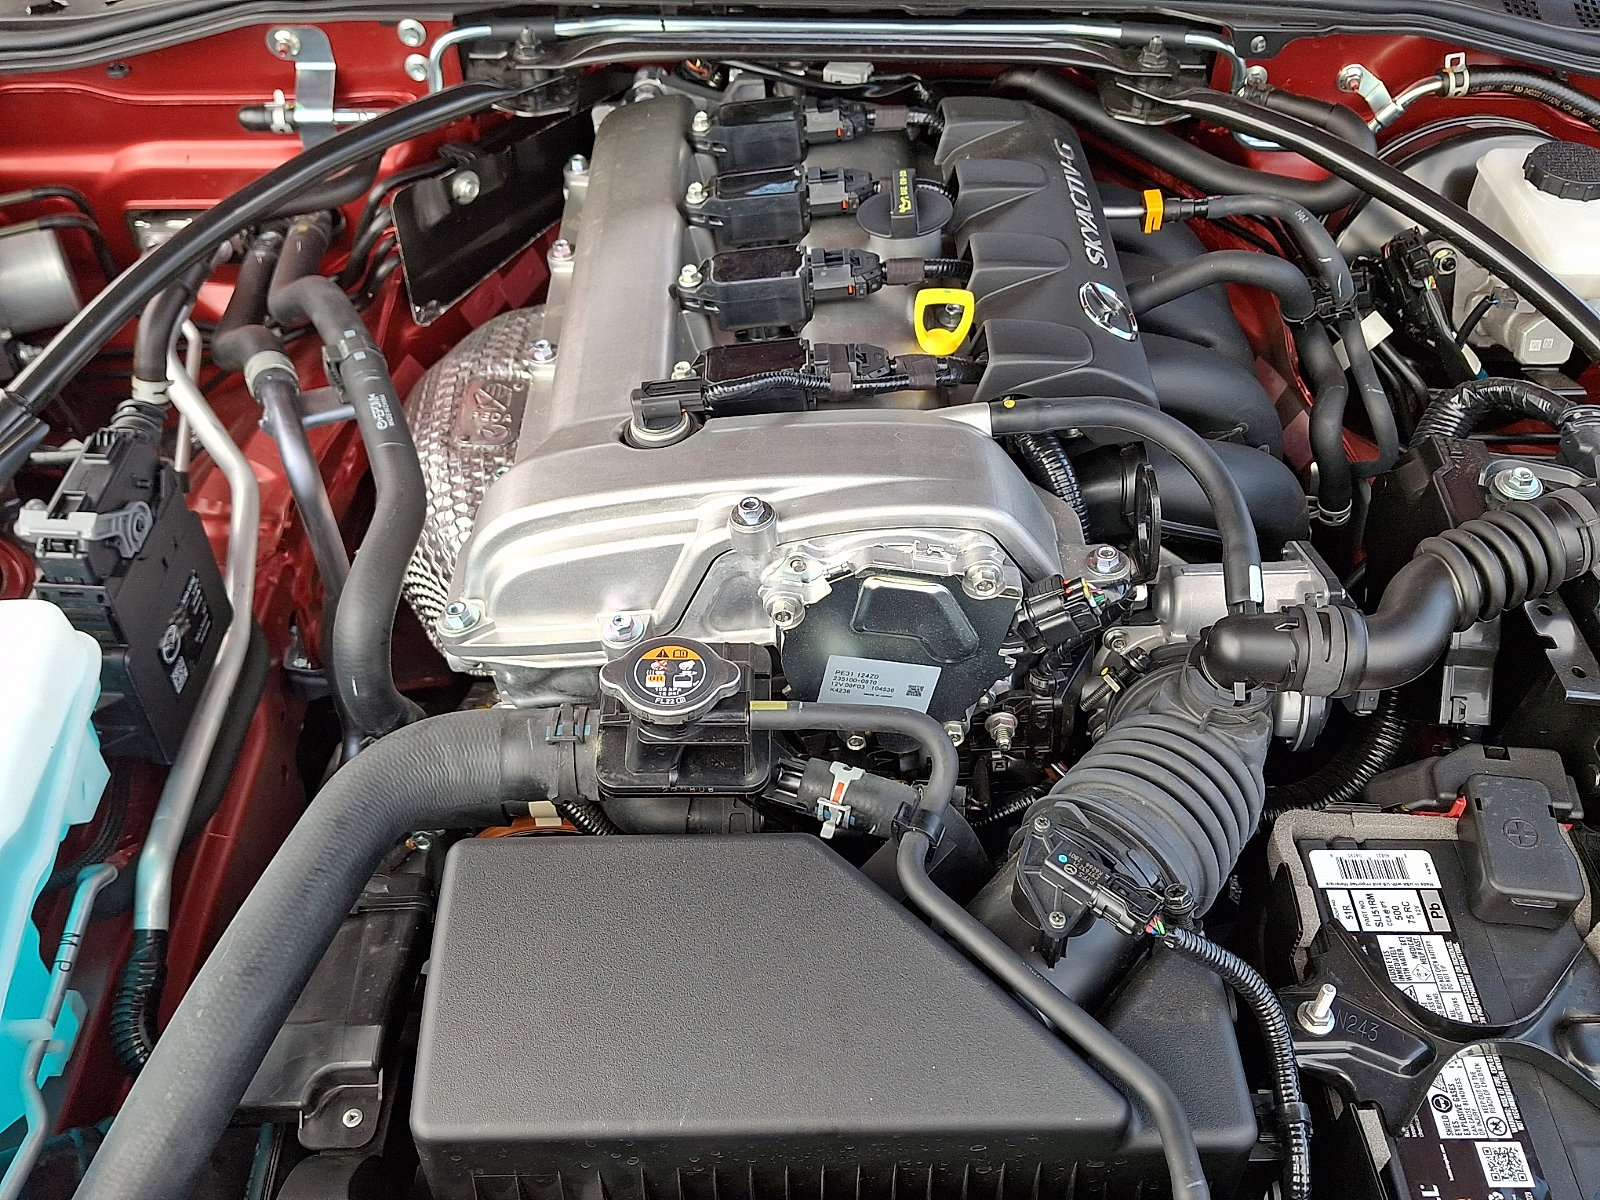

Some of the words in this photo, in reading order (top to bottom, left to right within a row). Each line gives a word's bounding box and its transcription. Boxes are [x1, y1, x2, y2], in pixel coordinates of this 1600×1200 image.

[1053, 139, 1109, 269] SKYACTIV-G
[1342, 905, 1354, 920] 51R
[1392, 905, 1404, 920] 500
[1402, 901, 1412, 912] RC
[1429, 902, 1444, 920] Pb
[1361, 910, 1371, 926] PART
[1406, 914, 1416, 924] 75
[1383, 950, 1392, 964] EYES
[1406, 936, 1418, 960] MEDICAL
[1388, 946, 1406, 982] IMMEDIATELY
[1418, 951, 1427, 965] HELP
[1388, 964, 1398, 982] FLUSH
[1402, 967, 1412, 982] WITH
[1335, 1009, 1380, 1042] N243
[1470, 1070, 1478, 1080] THE
[1448, 1083, 1461, 1102] GASES
[1455, 1077, 1469, 1106] BLINDNESS
[1476, 1090, 1484, 1100] OUT
[1480, 1100, 1490, 1114] KEEP
[1486, 1096, 1497, 1114] REACH
[1456, 1104, 1472, 1136] EXPLOSIVE
[1464, 1106, 1475, 1124] CAUSE
[1441, 1115, 1454, 1136] SHIELD
